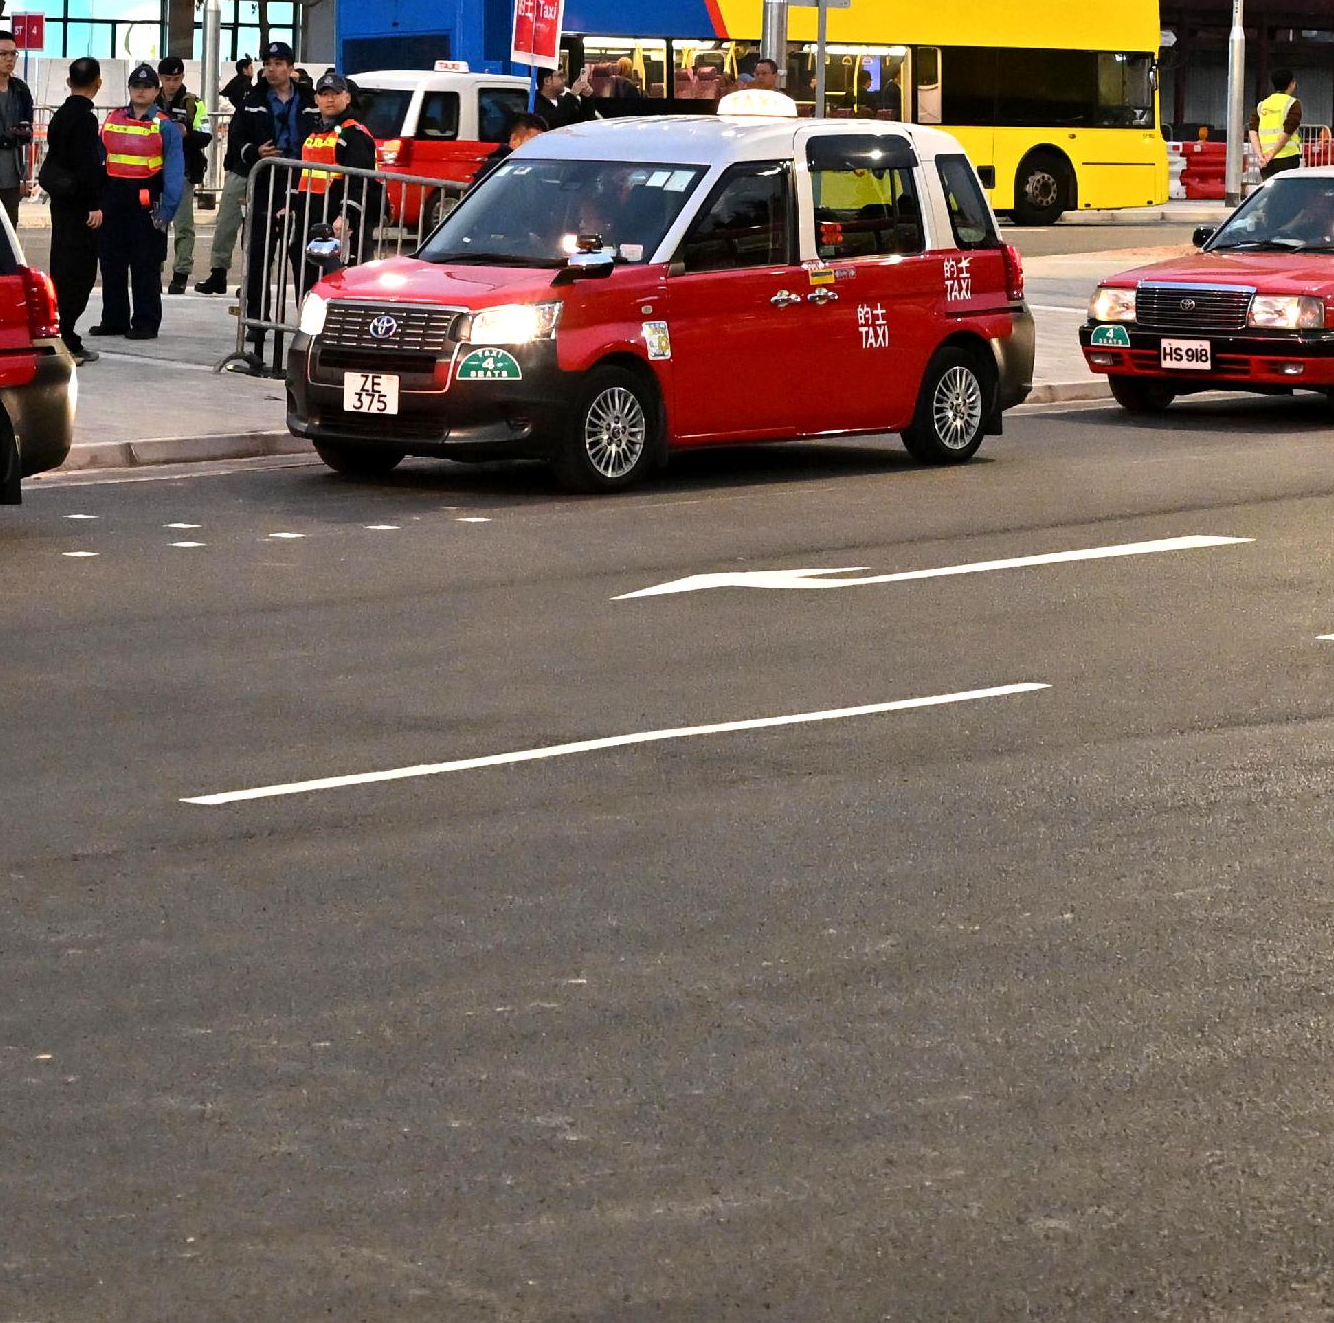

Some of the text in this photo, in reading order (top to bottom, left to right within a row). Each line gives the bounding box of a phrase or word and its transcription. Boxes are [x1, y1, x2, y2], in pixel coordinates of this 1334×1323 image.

[539, 0, 558, 19] Taxi
[15, 25, 37, 35] ST 4
[944, 257, 971, 278] 的士
[945, 279, 971, 301] TAXI
[857, 303, 887, 325] 的士
[859, 326, 888, 349] TAXI
[1106, 328, 1114, 339] 4
[478, 350, 503, 359] TAXI
[482, 357, 495, 369] 4
[470, 370, 508, 378] SEATS
[360, 374, 382, 394] ZE
[352, 393, 387, 412] 375
